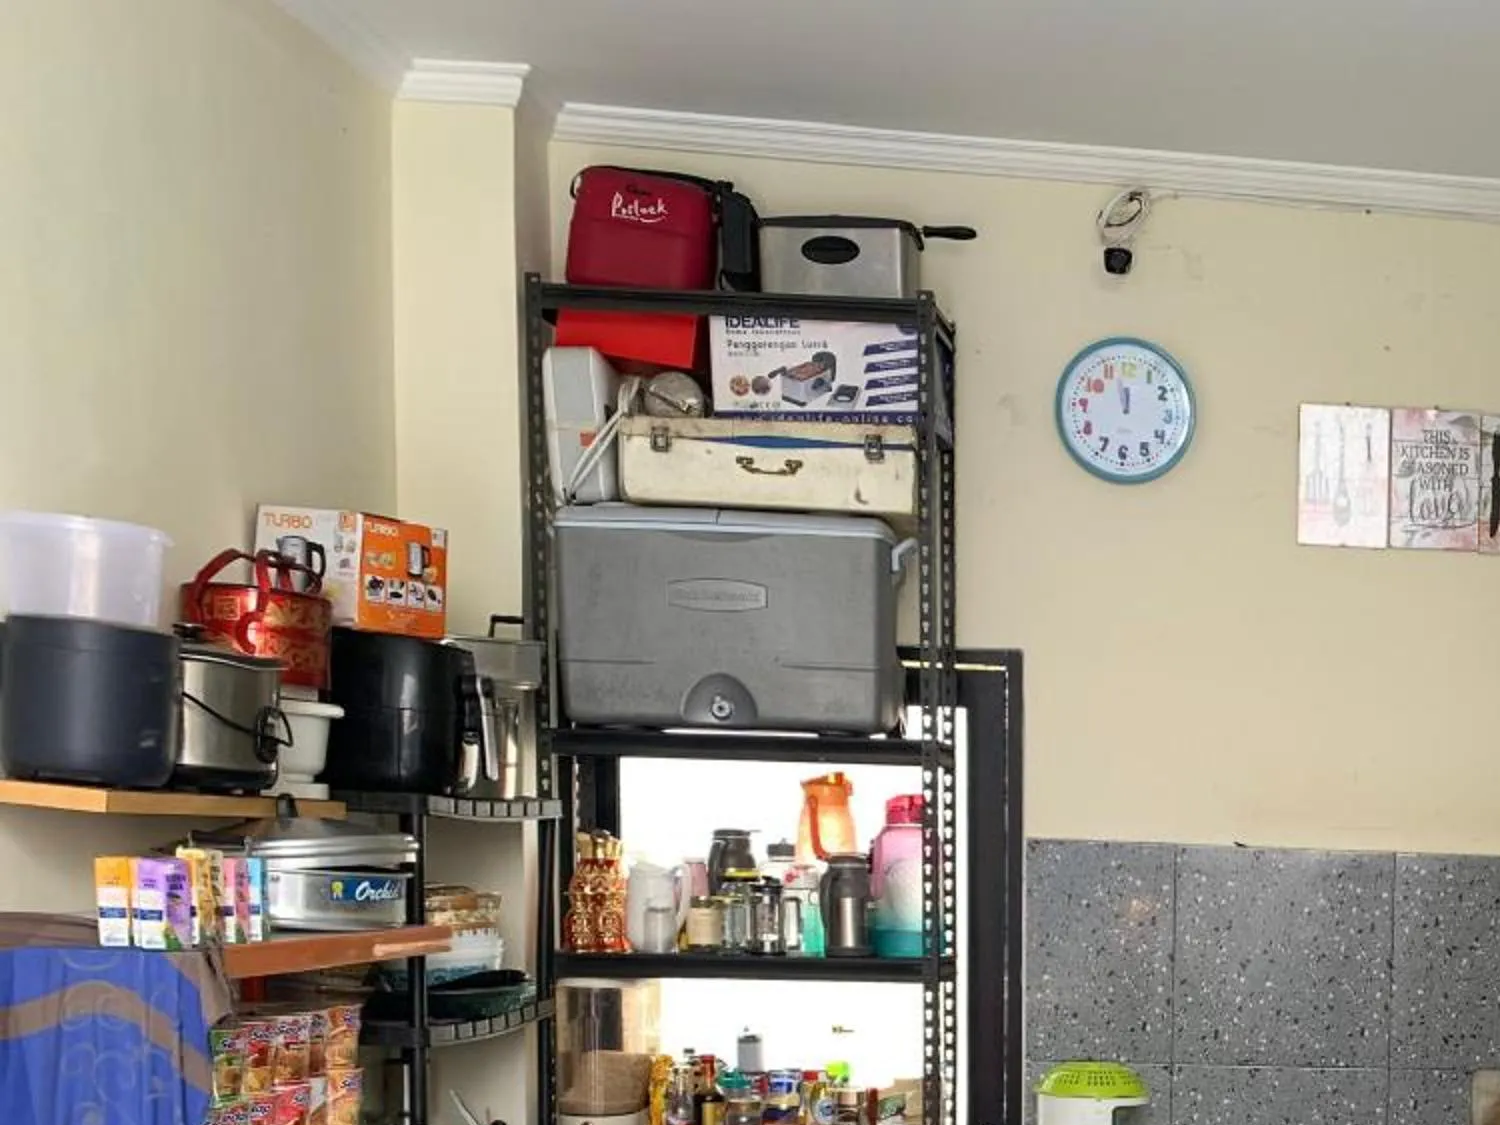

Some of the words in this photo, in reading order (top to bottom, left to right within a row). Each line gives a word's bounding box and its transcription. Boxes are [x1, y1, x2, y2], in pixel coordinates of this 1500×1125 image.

[1121, 362, 1137, 379] 12
[1157, 385, 1168, 402] 2
[1078, 398, 1089, 414] 9
[1162, 408, 1173, 425] 3
[1082, 420, 1093, 436] 8
[1098, 436, 1110, 453] 7
[1153, 429, 1166, 445] 4
[1422, 429, 1452, 445] THIS
[1117, 445, 1129, 461] 6
[1139, 441, 1150, 457] 5
[1400, 444, 1456, 460] KITCHEN
[263, 512, 312, 530] TURBO
